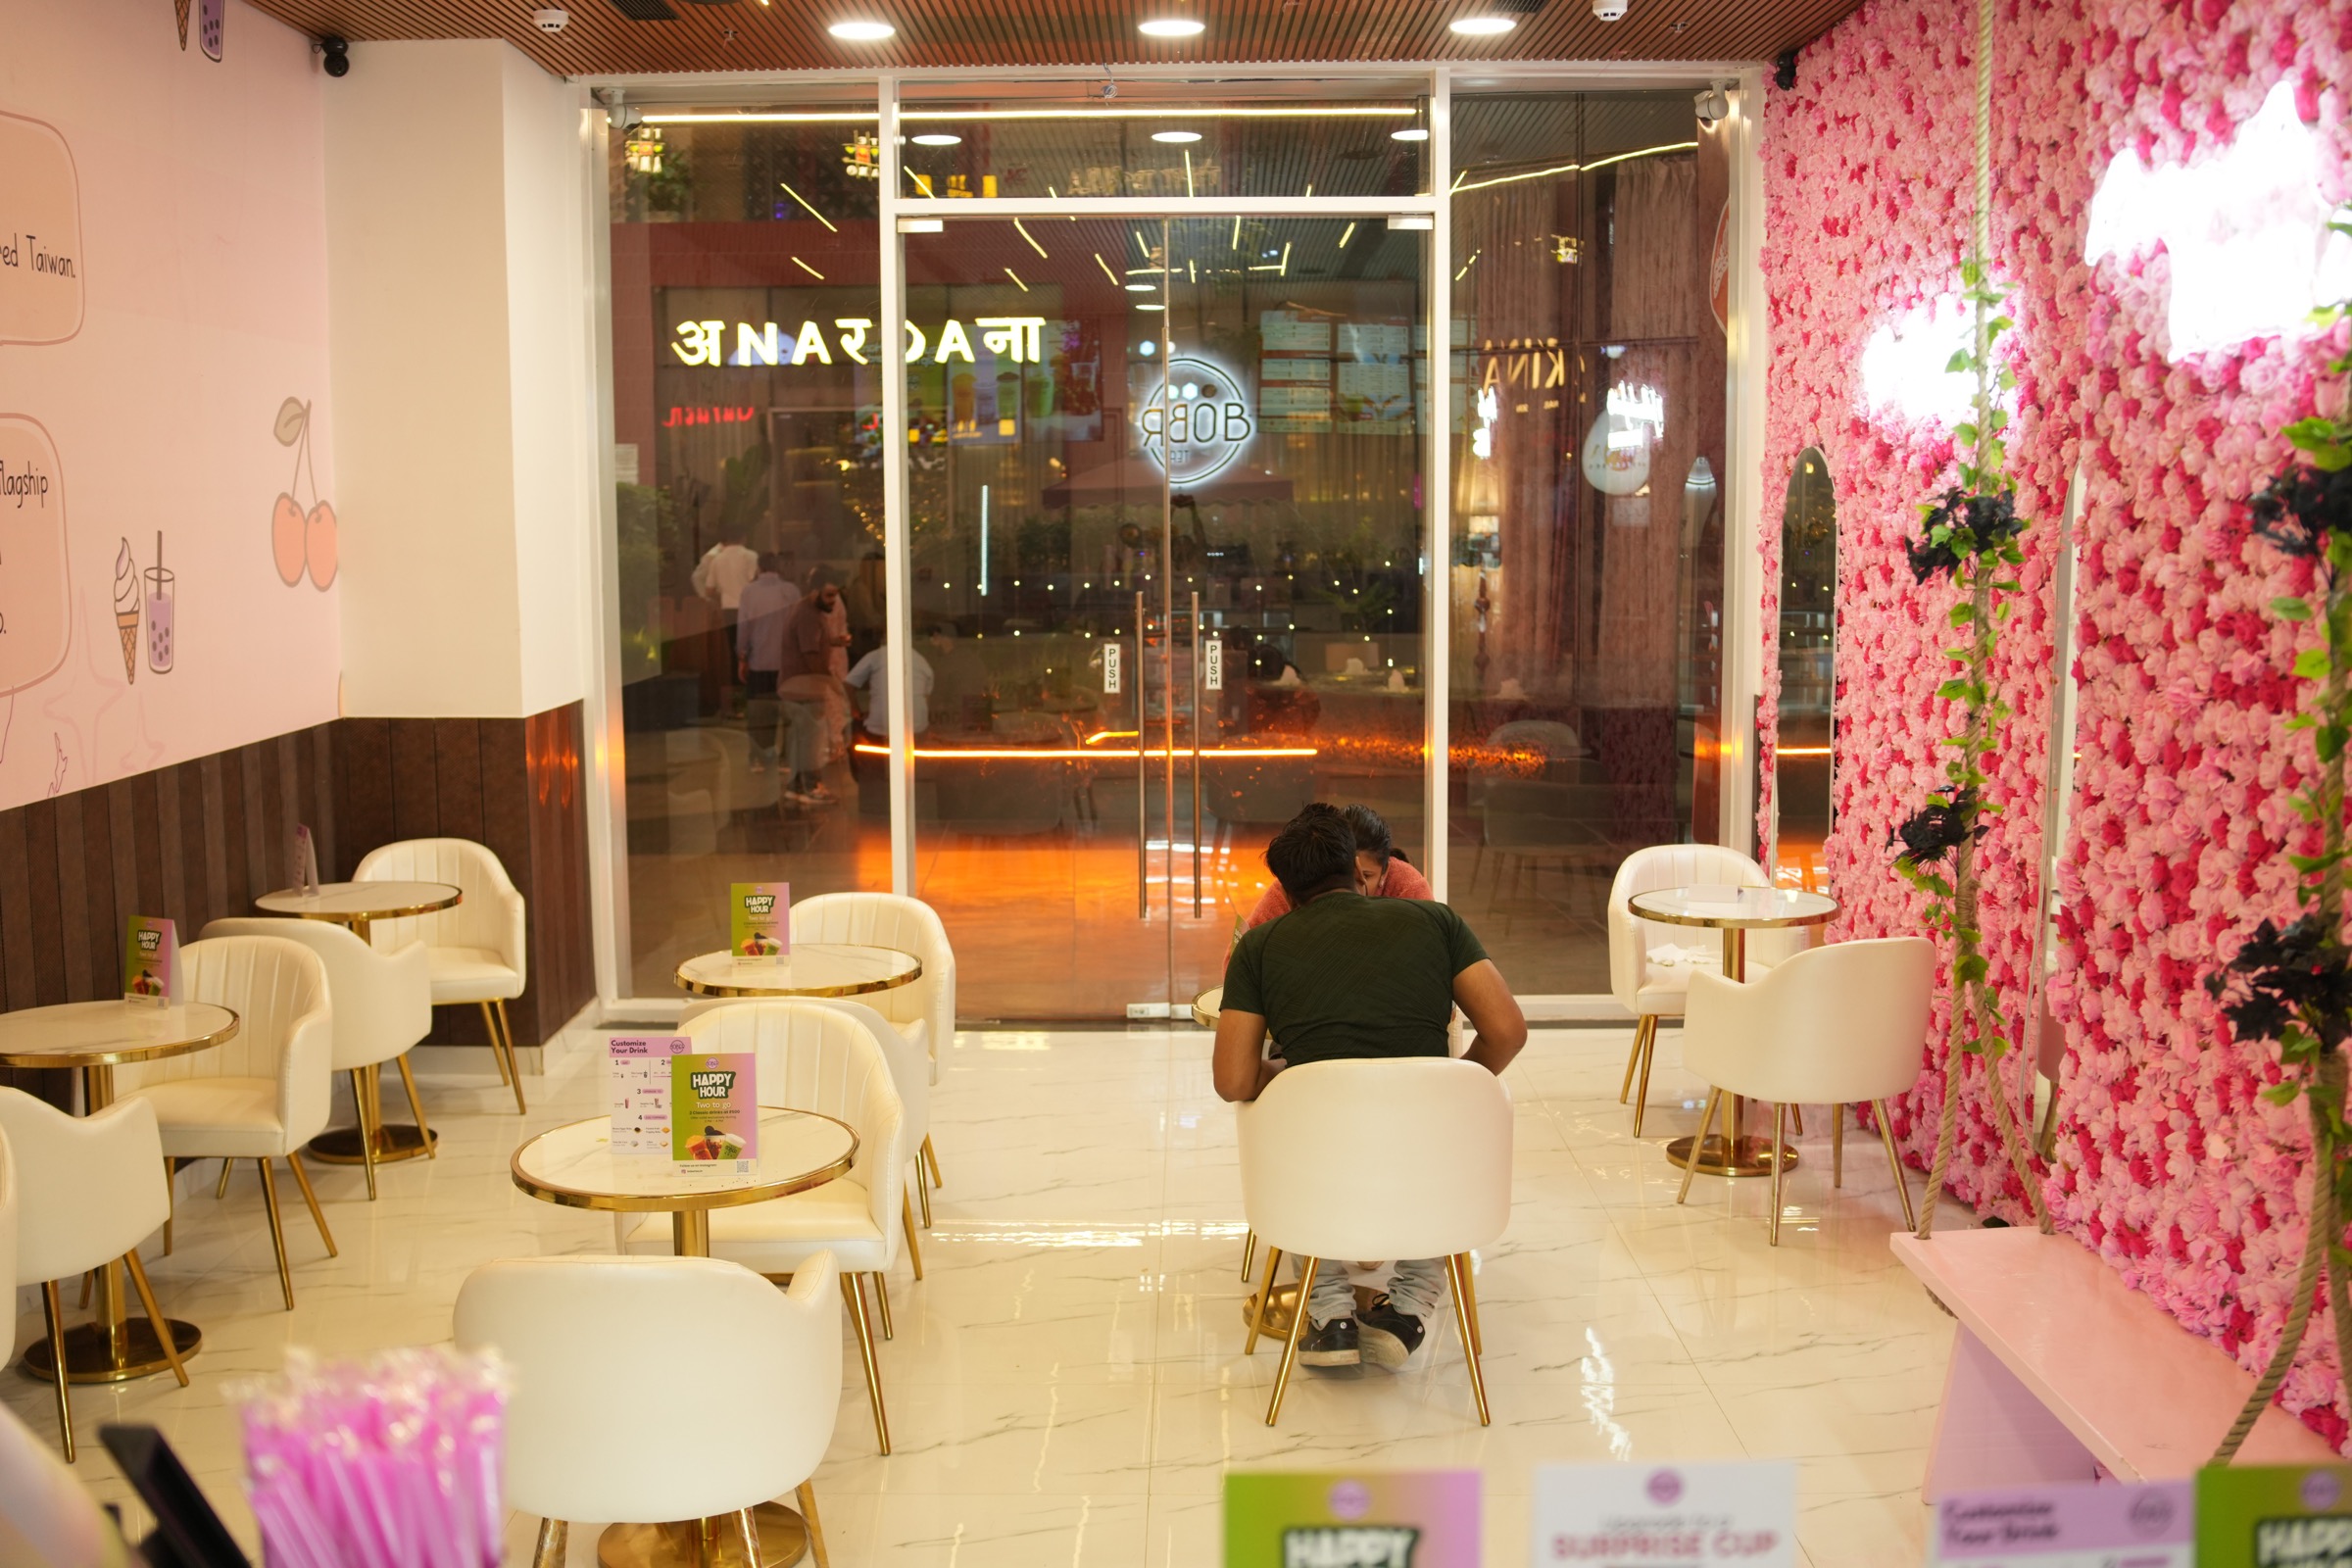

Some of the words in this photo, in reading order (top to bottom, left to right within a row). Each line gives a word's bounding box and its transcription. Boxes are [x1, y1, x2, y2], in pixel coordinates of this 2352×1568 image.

[0, 232, 19, 268] ed
[25, 235, 76, 278] Taiwan.
[1108, 648, 1117, 689] PUSH
[1209, 645, 1218, 686] PUSH
[745, 896, 773, 907] HAPPY
[750, 906, 769, 914] HOUR
[138, 931, 161, 943] HAPPY
[141, 941, 156, 951] HOUR
[692, 1073, 733, 1088] HAPPY
[699, 1086, 726, 1098] HOUR
[1284, 1529, 1417, 1568] HAPPY
